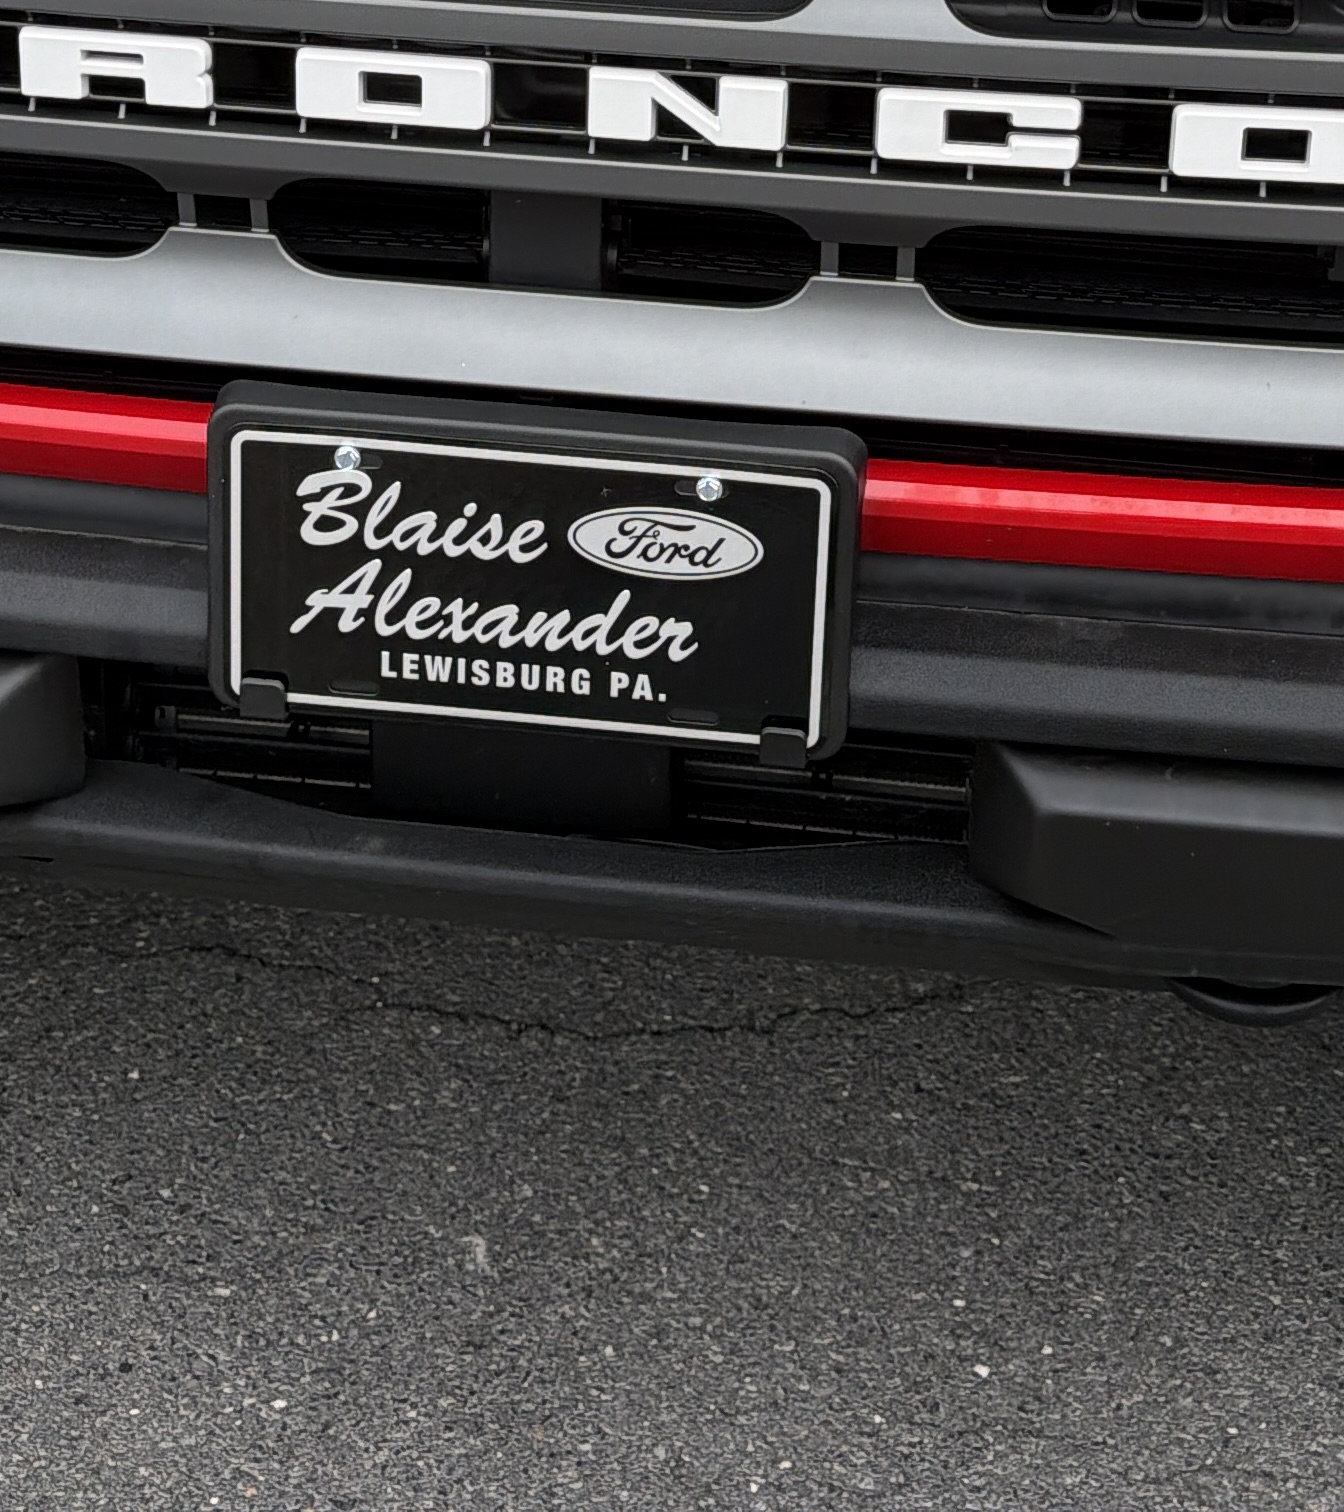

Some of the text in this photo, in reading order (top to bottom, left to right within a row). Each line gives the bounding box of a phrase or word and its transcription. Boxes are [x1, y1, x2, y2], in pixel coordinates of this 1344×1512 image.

[296, 469, 725, 569] Blaise Ford
[289, 558, 699, 662] Alexander
[380, 650, 668, 702] LEWISBURG PA.
